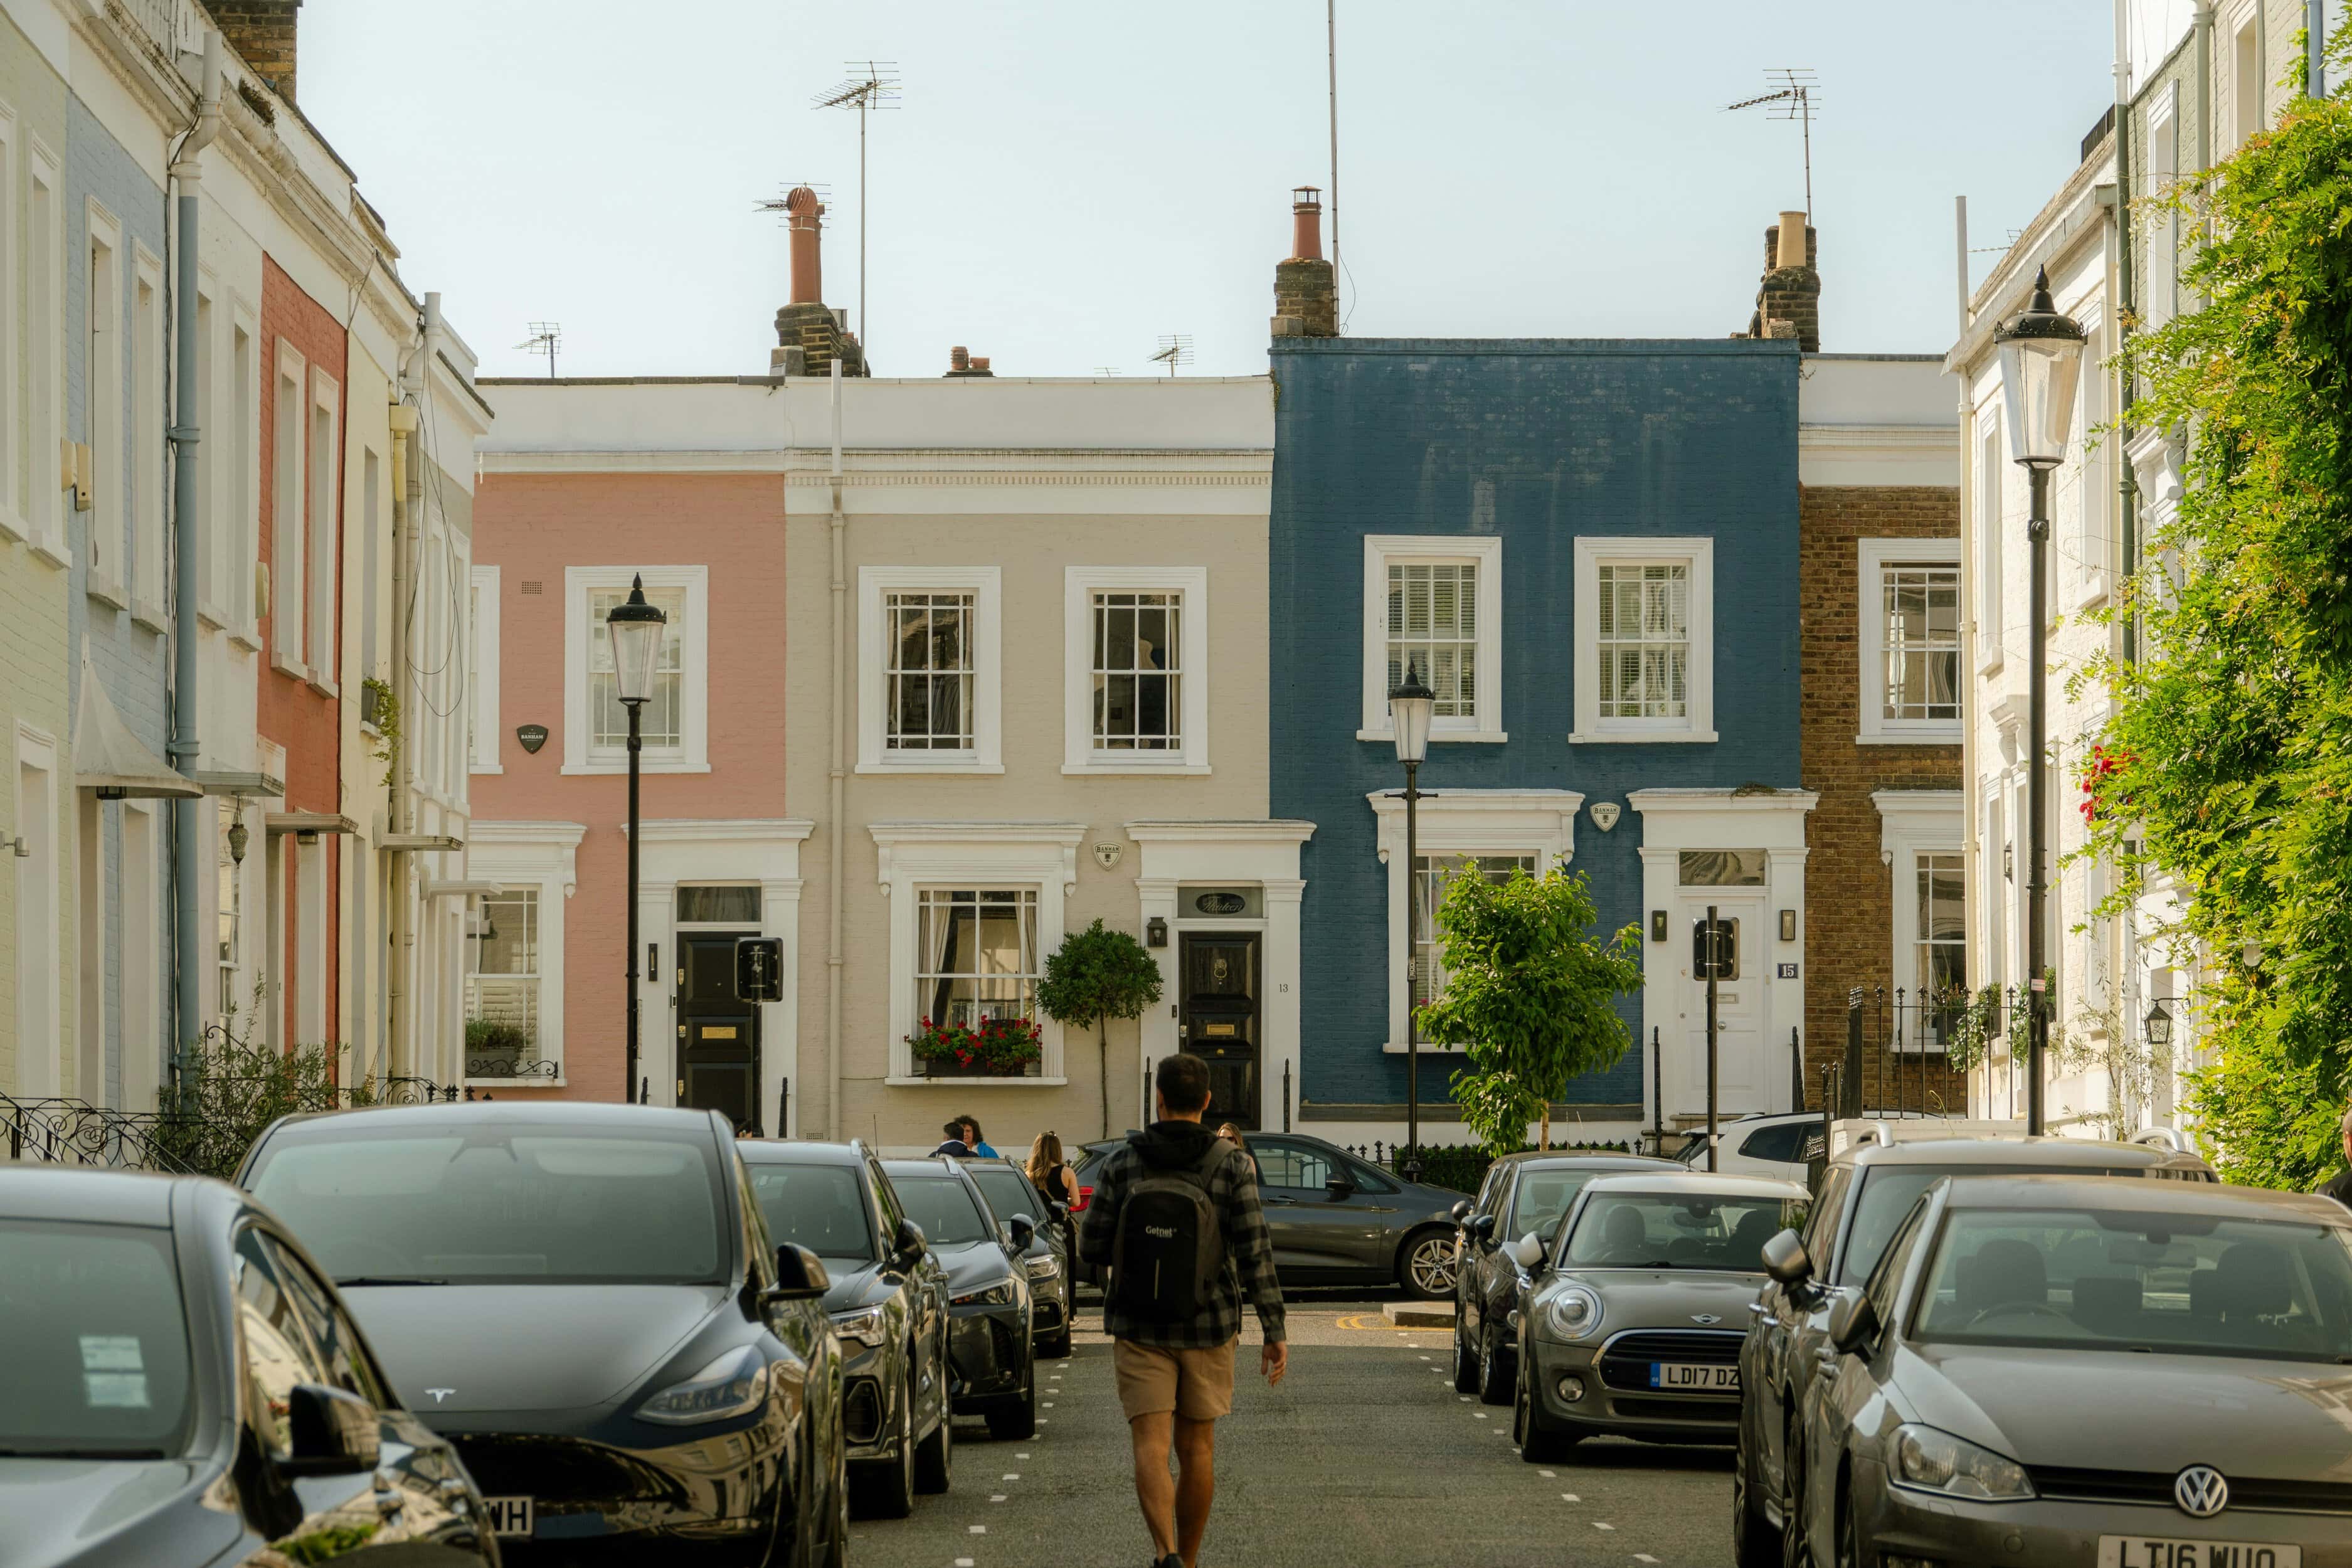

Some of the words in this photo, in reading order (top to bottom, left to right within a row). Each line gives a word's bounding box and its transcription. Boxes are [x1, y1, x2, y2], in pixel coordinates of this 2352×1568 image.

[1782, 965, 1794, 978] 15
[1279, 983, 1289, 993] 13
[1668, 1367, 1710, 1385] LD17
[2120, 1540, 2197, 1568] LT16
